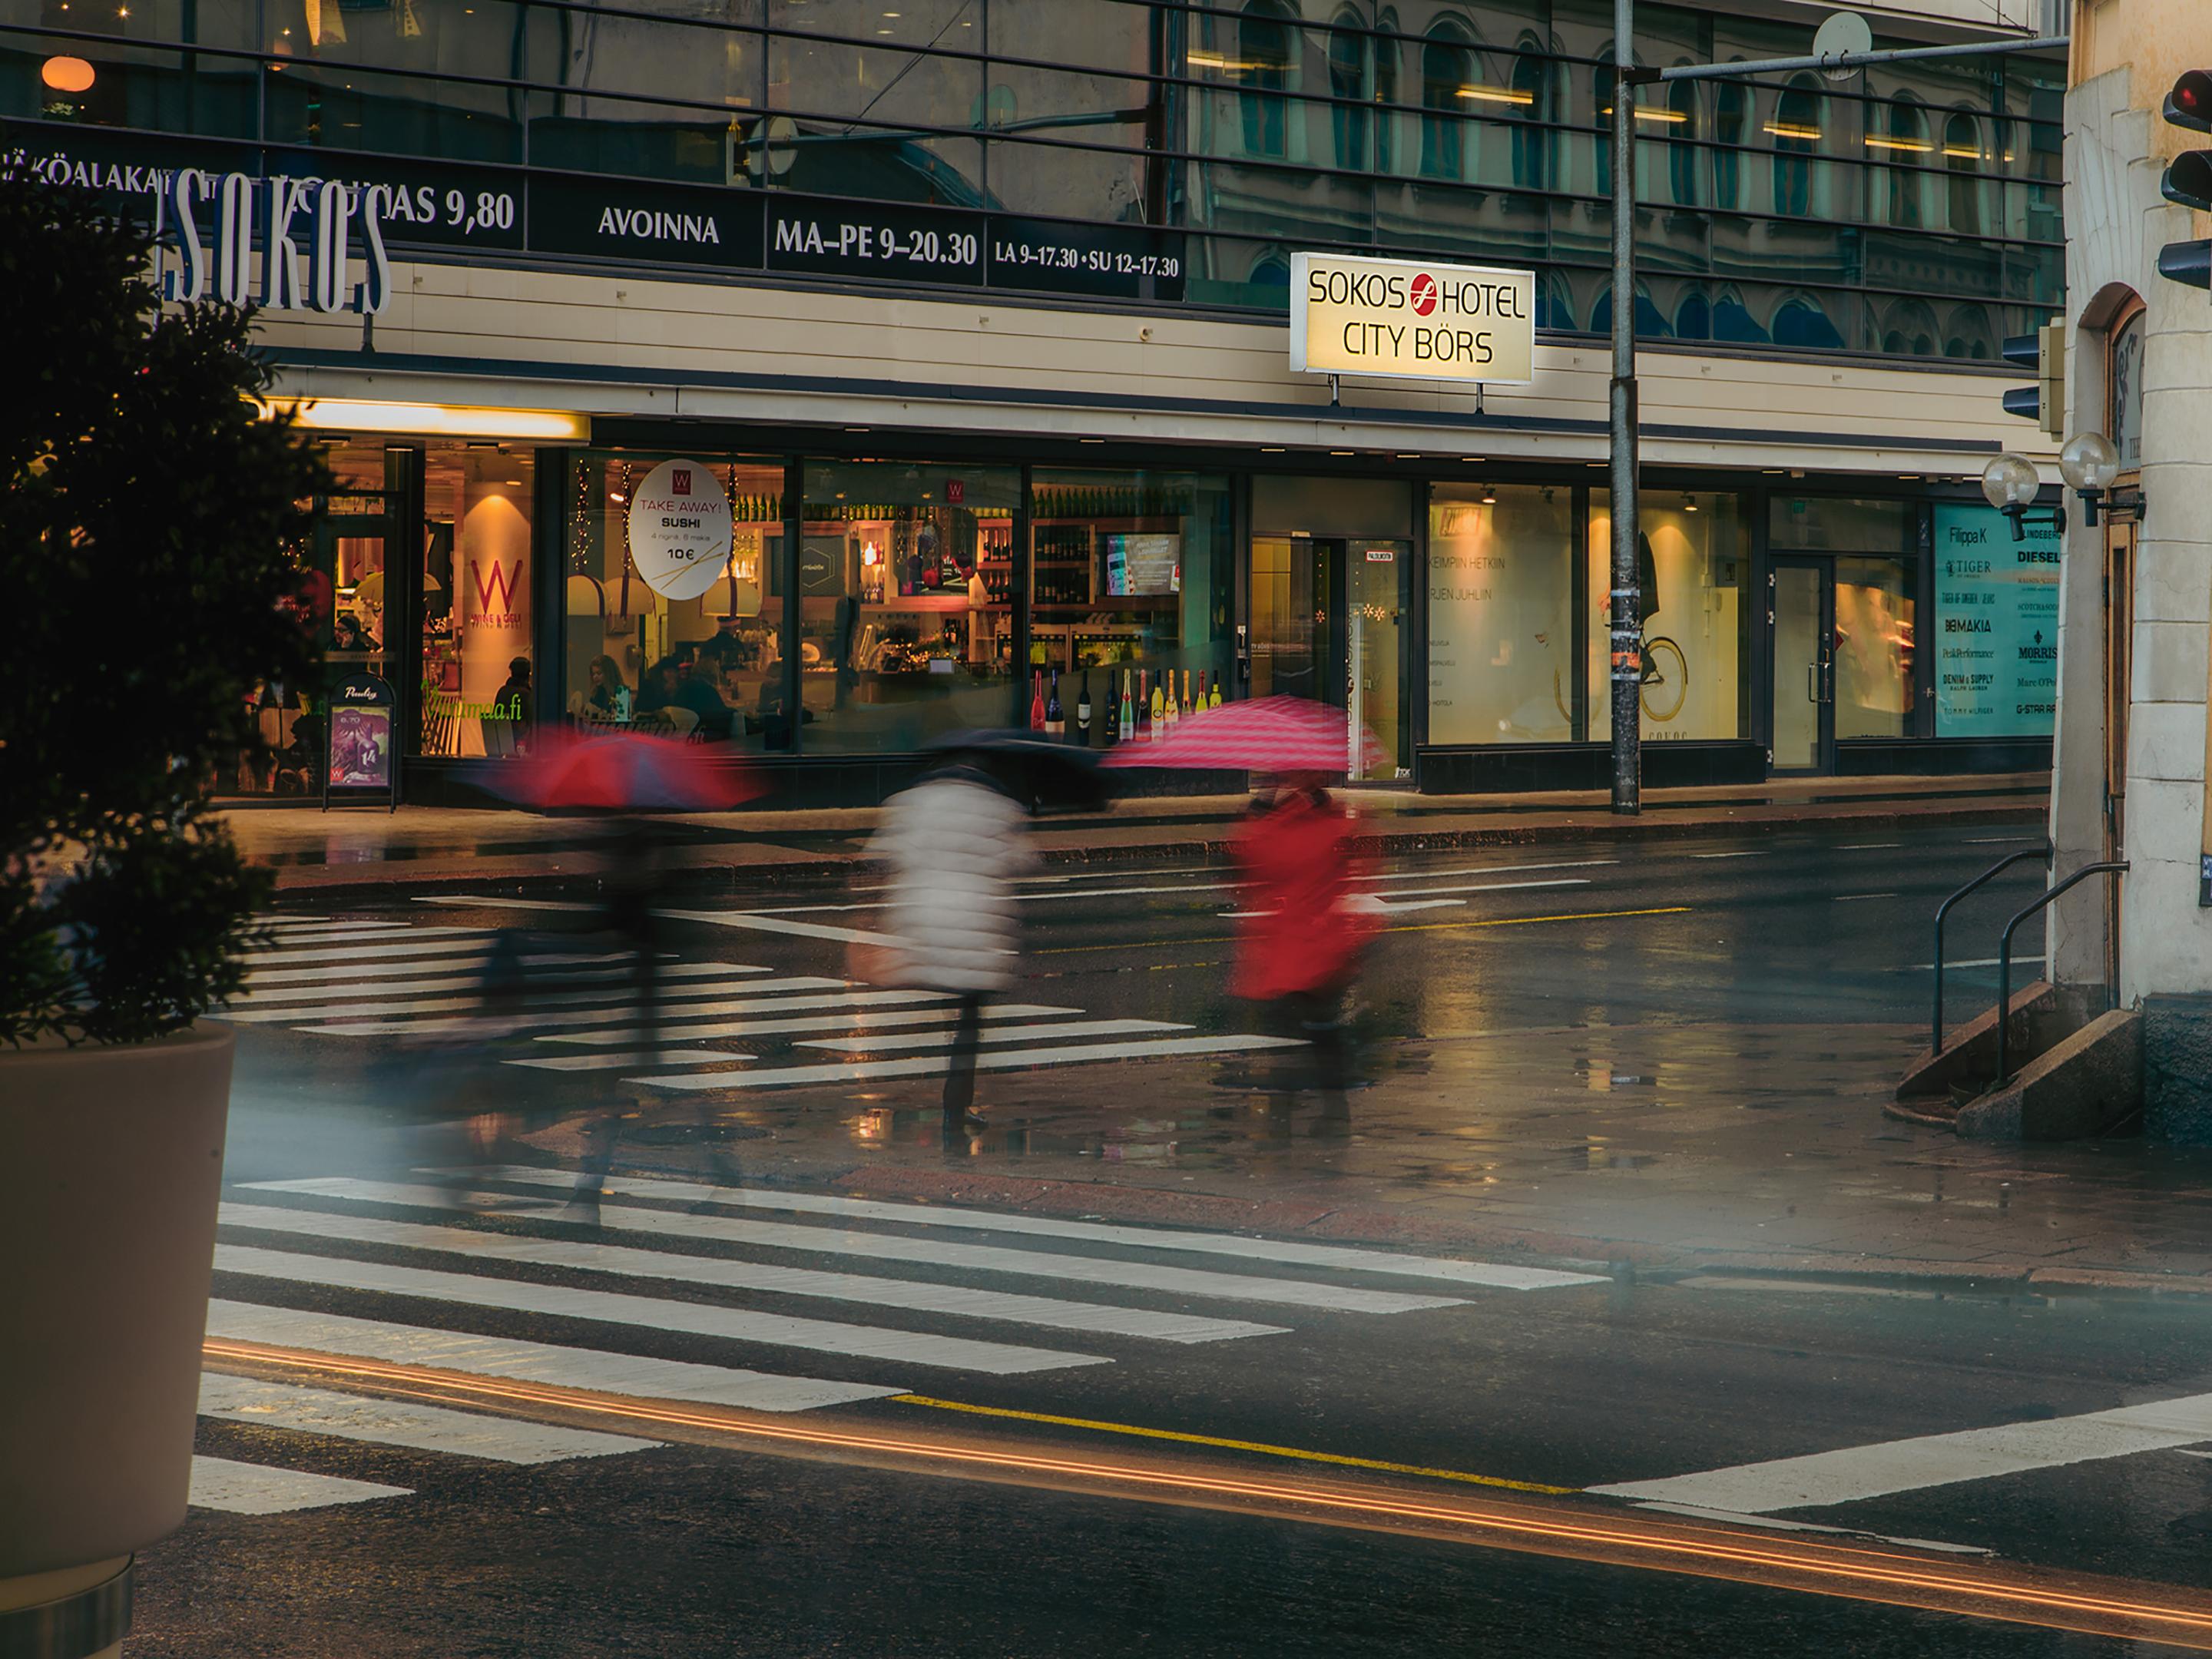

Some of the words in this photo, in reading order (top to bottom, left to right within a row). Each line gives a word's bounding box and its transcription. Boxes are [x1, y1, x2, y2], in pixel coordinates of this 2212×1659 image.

[446, 190, 514, 234] 9,80
[598, 207, 719, 243] AVOINNA
[164, 167, 390, 313] SOKOS
[775, 220, 872, 257] MA–PE
[879, 228, 977, 265] 9–20.30
[995, 242, 1017, 263] LA
[1089, 250, 1111, 271] SU
[1115, 253, 1179, 277] 12–17.30
[1310, 270, 1405, 308] SOKOS
[1442, 281, 1525, 319] HOTEL
[1344, 322, 1406, 357] CITY
[1416, 323, 1493, 363] BÖRS
[675, 474, 689, 486] W
[949, 485, 962, 496] W
[641, 500, 674, 511] TAKE
[680, 502, 721, 514] AWAY!
[662, 518, 700, 528] SUSHI
[1949, 527, 1978, 547] Filippa
[1980, 528, 1988, 543] K
[667, 549, 694, 560] 10€
[2018, 551, 2061, 563] DIESEL
[1956, 560, 1992, 573] TIGER
[471, 560, 523, 614] W
[1958, 619, 1991, 633] MAKIA
[2018, 647, 2058, 659] MORRIS
[1943, 674, 1965, 684] DENIM
[1971, 674, 1994, 684] SUPPLY
[2017, 677, 2037, 687] Marc
[2016, 704, 2045, 714] G-STAR
